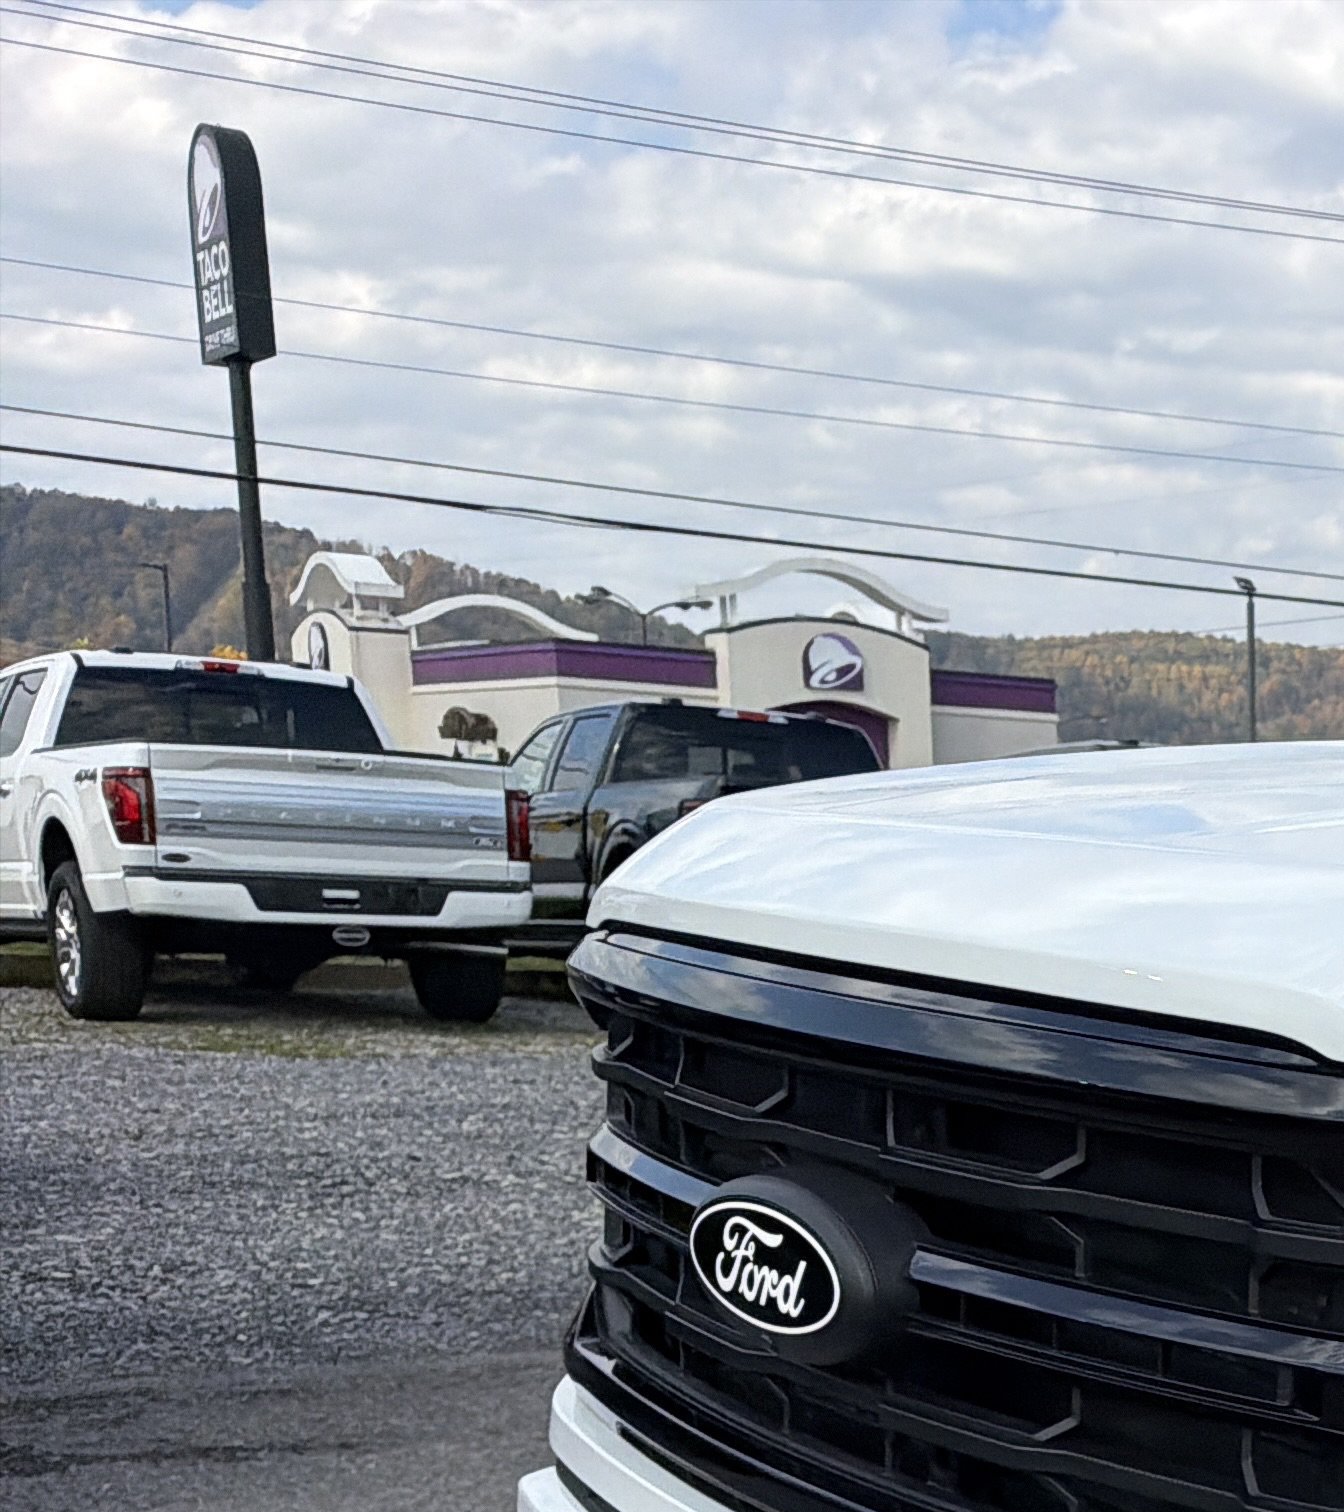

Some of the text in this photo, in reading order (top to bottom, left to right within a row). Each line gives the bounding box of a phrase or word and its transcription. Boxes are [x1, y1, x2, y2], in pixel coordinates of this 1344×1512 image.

[196, 240, 229, 286] TACO
[202, 283, 234, 324] BELL
[715, 1215, 807, 1318] Ford
